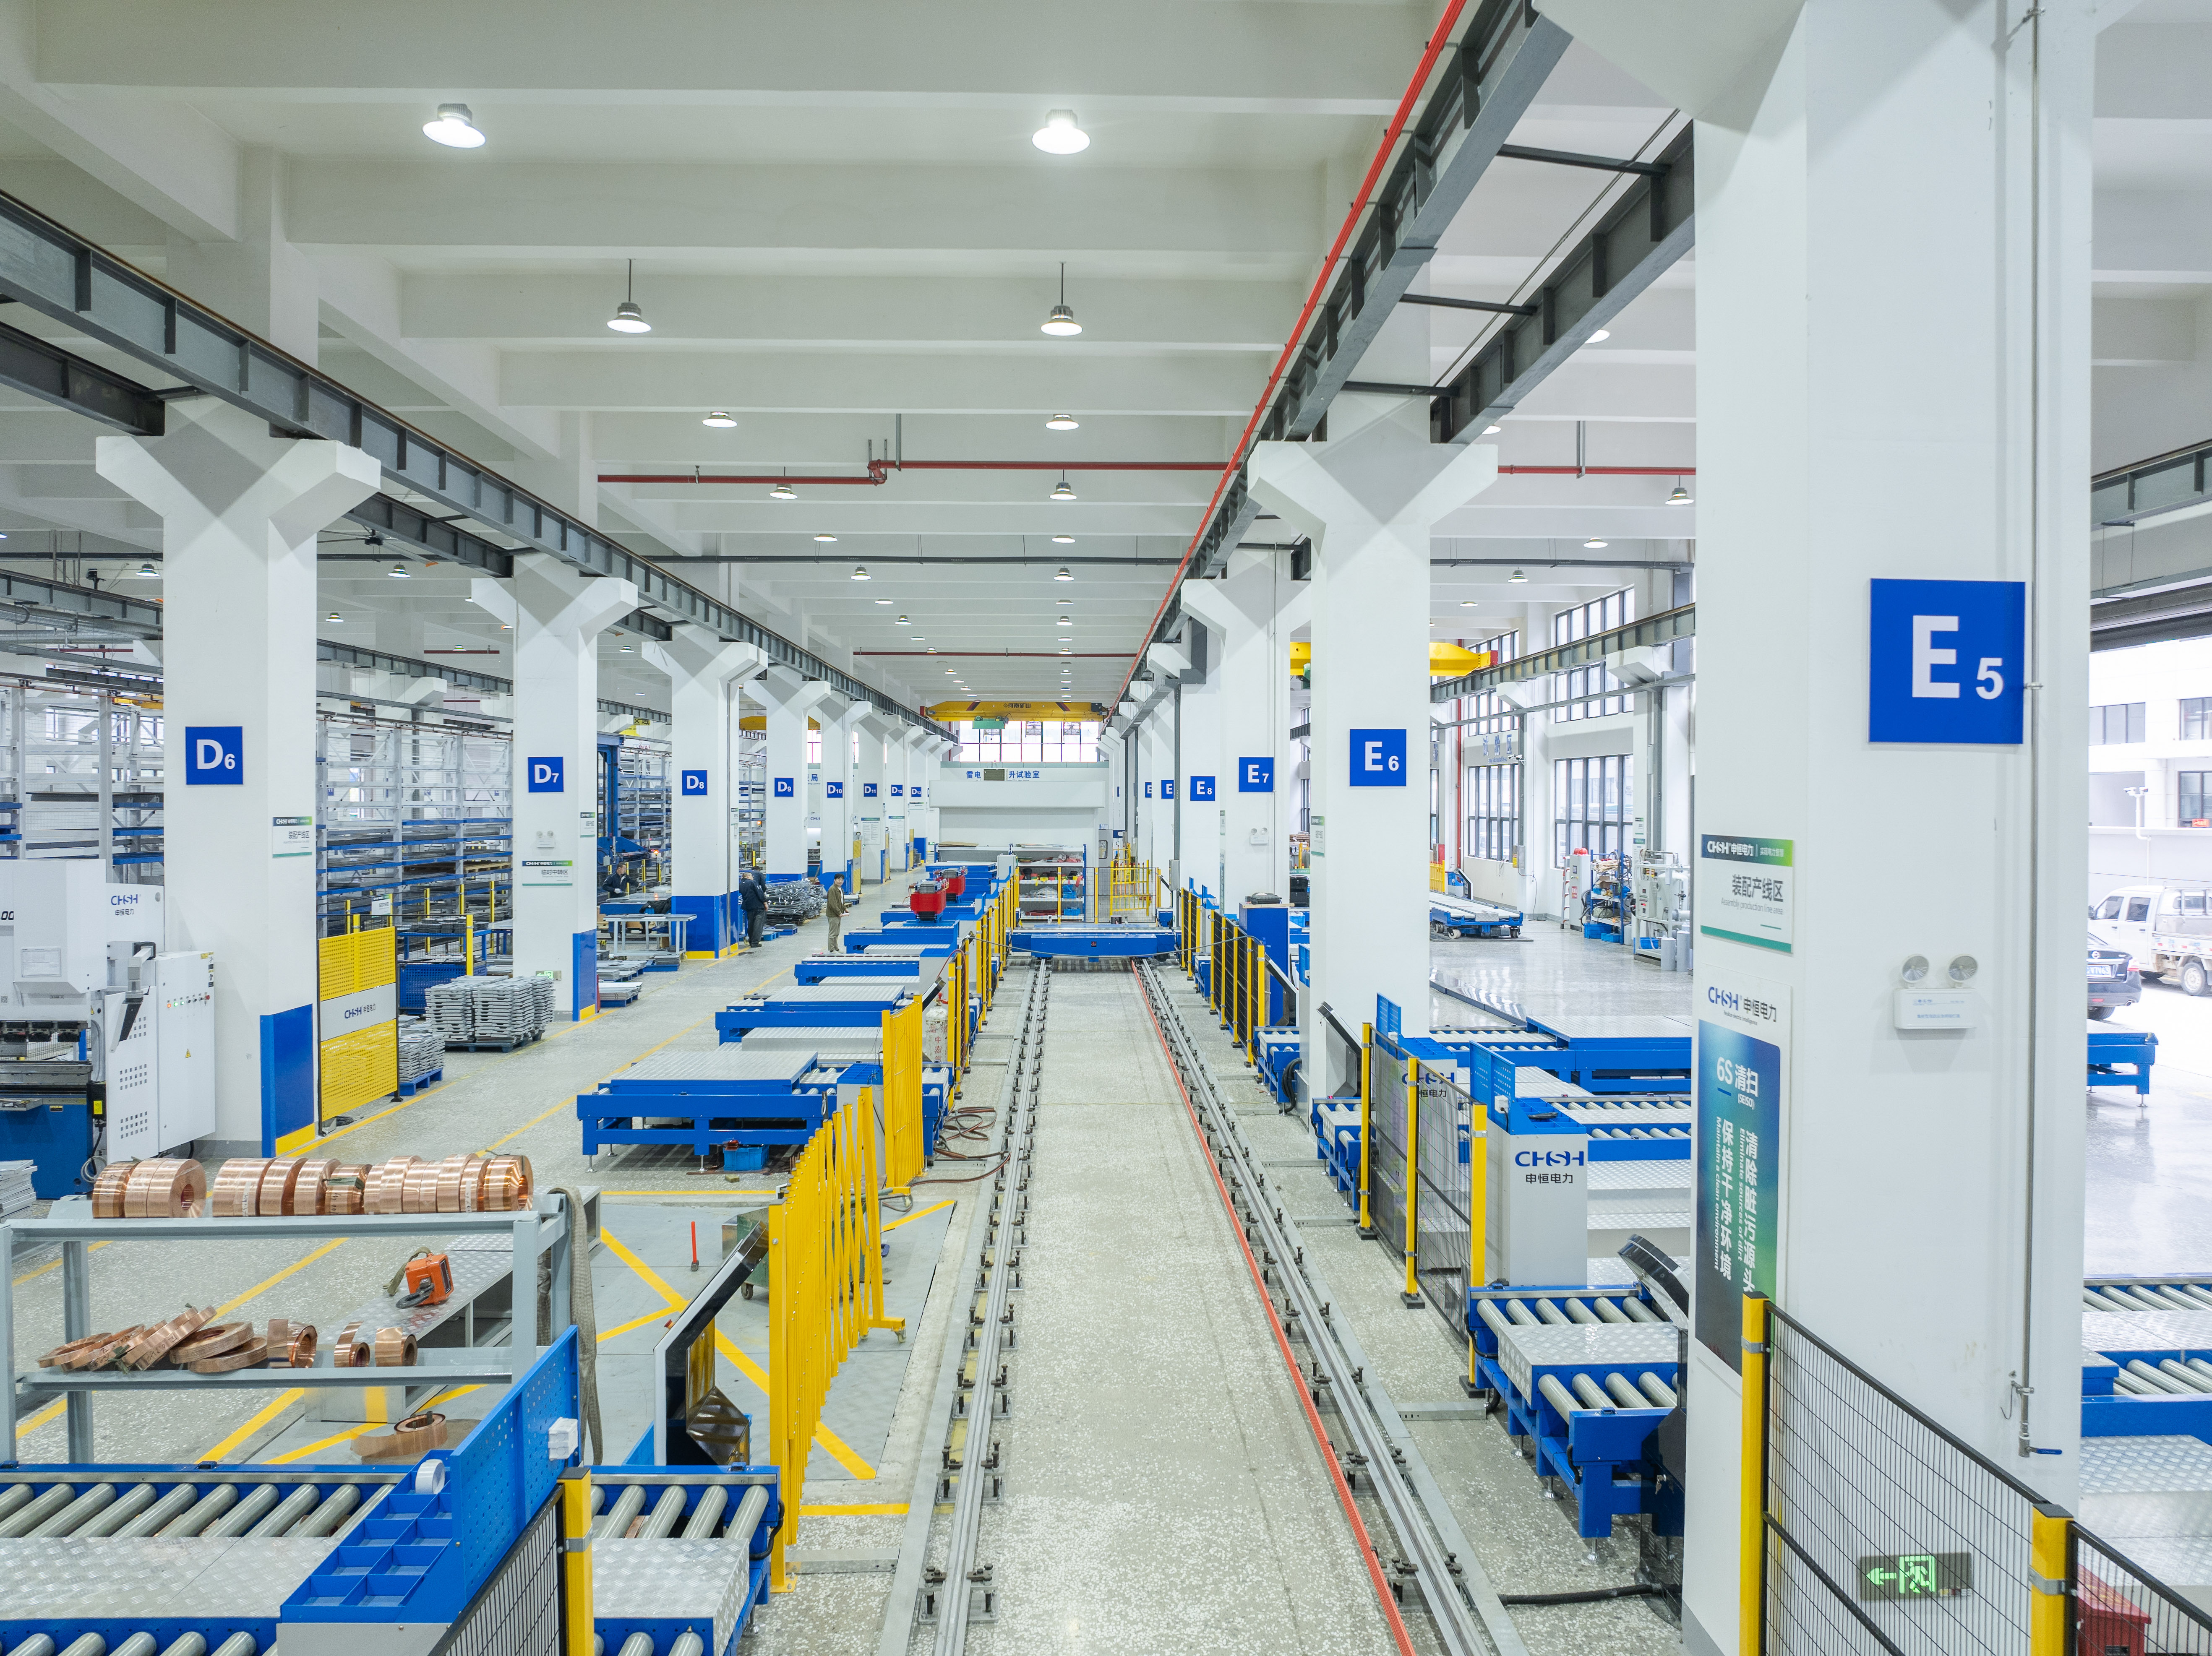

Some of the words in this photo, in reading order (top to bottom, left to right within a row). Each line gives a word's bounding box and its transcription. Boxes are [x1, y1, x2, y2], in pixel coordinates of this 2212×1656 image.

[196, 739, 235, 770] D6
[534, 764, 559, 784] D7
[686, 776, 705, 789] D8
[777, 781, 791, 792] D9
[828, 785, 842, 794] D10
[1707, 841, 1729, 854] CHSH
[1731, 843, 1754, 856] 申恒电力
[1732, 874, 1783, 902] 装配产线区
[111, 894, 138, 906] CHSH
[1721, 897, 1740, 909] Assembly
[1740, 901, 1763, 912] production
[1764, 904, 1772, 913] line
[1708, 986, 1738, 1011] CHSH
[1743, 997, 1777, 1023] 申恒电力
[344, 1006, 362, 1019] CHSH
[1717, 1056, 1733, 1086] 6S
[1735, 1063, 1759, 1098] 清扫
[1419, 1088, 1447, 1098] 恒电力
[1737, 1093, 1755, 1110] (SEISO)
[1515, 1151, 1584, 1166] CHSH
[1526, 1173, 1573, 1184] 申恒电力
[1719, 1118, 1734, 1281] 保持干净环境
[1742, 1130, 1759, 1292] 清除脏污源头
[1738, 1226, 1743, 1237] of
